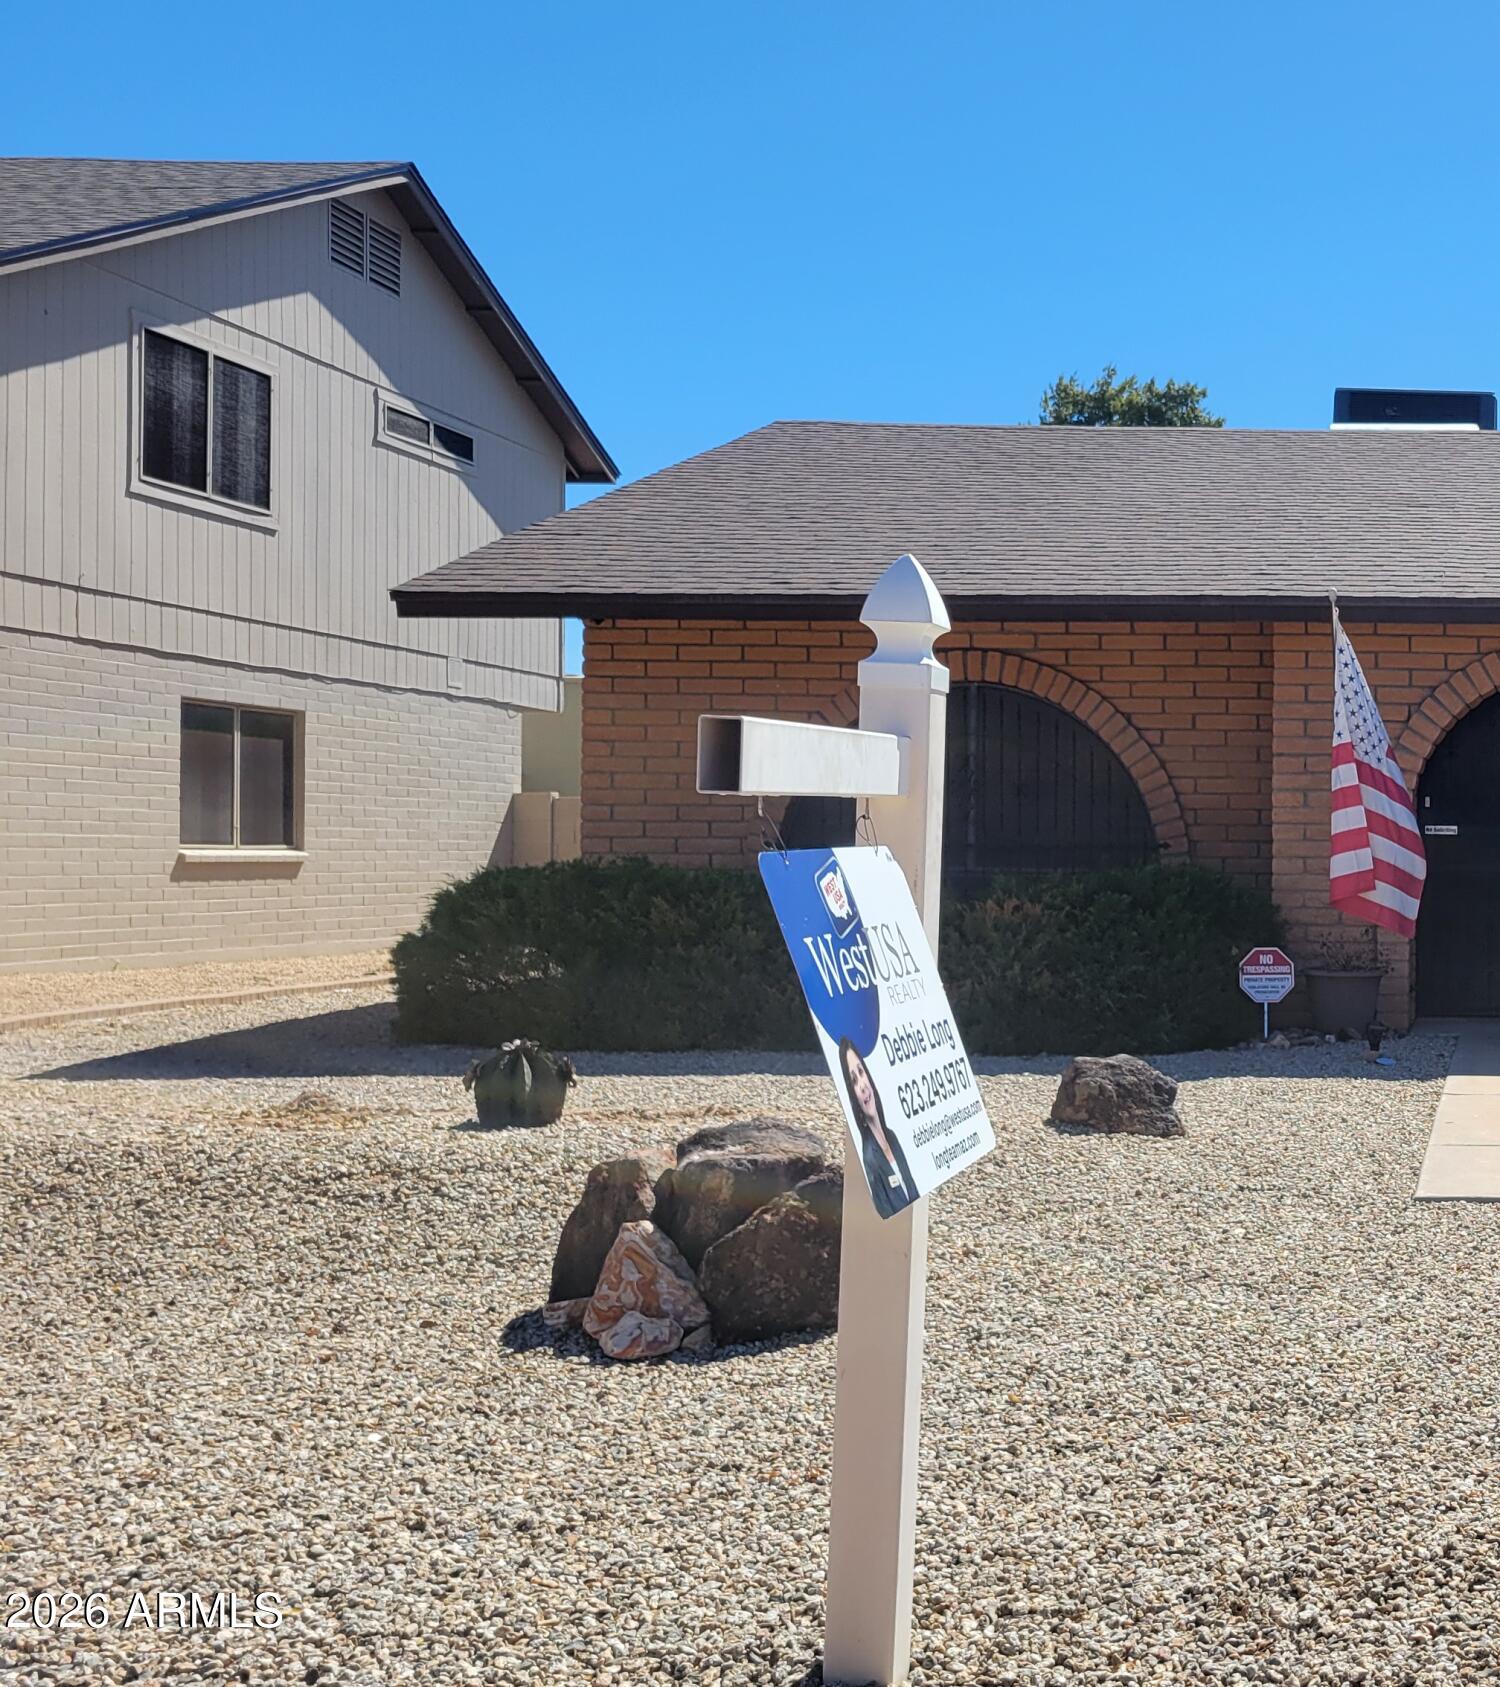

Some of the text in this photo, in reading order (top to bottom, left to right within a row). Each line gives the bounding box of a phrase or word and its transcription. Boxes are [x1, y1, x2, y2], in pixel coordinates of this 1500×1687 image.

[1243, 965, 1291, 974] TRESPASSING
[1259, 954, 1274, 965] NO
[887, 978, 928, 1006] REALTY
[881, 1018, 957, 1067] Debbie Long
[897, 1057, 972, 1120] 623.249.9767
[912, 1100, 983, 1149] debbielong@westusa.com
[931, 1131, 982, 1171] longteamaz.com
